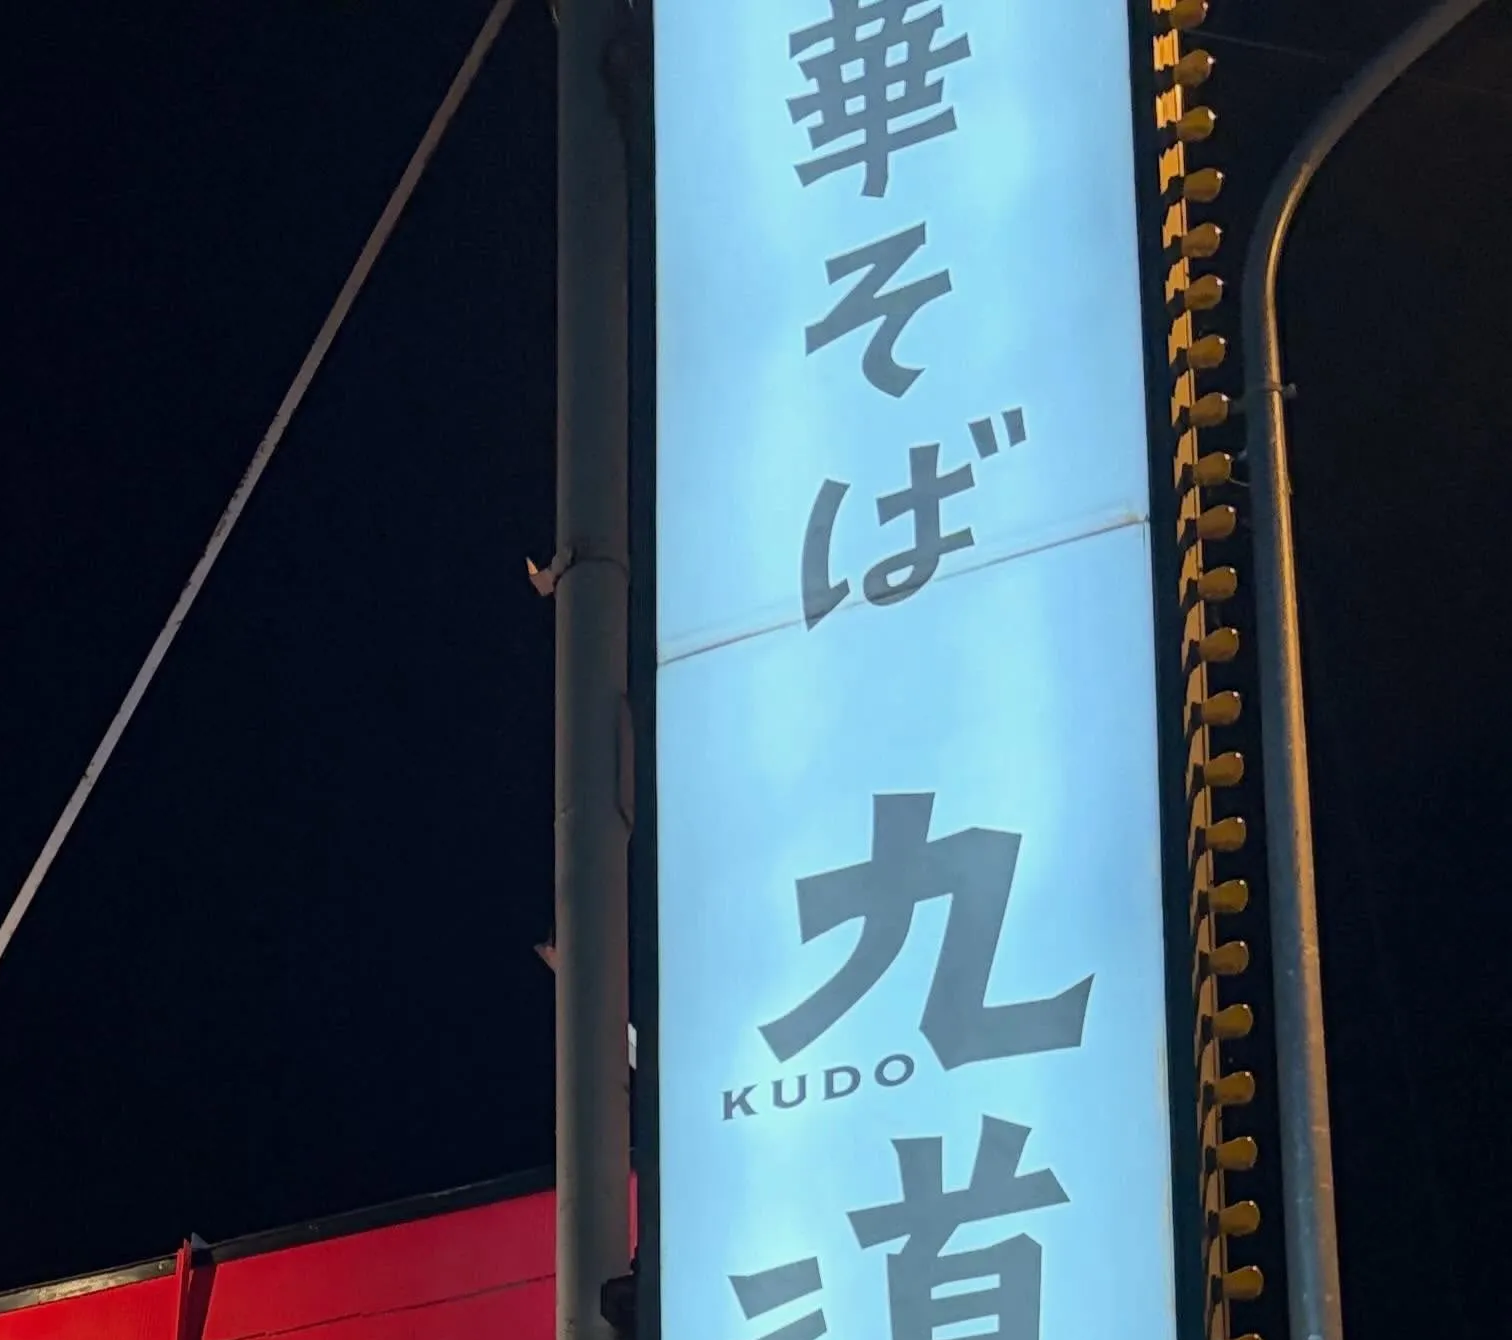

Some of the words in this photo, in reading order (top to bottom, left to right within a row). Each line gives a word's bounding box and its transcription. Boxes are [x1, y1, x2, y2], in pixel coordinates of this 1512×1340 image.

[786, 0, 1027, 632] 華そば
[722, 1053, 916, 1121] KUDO
